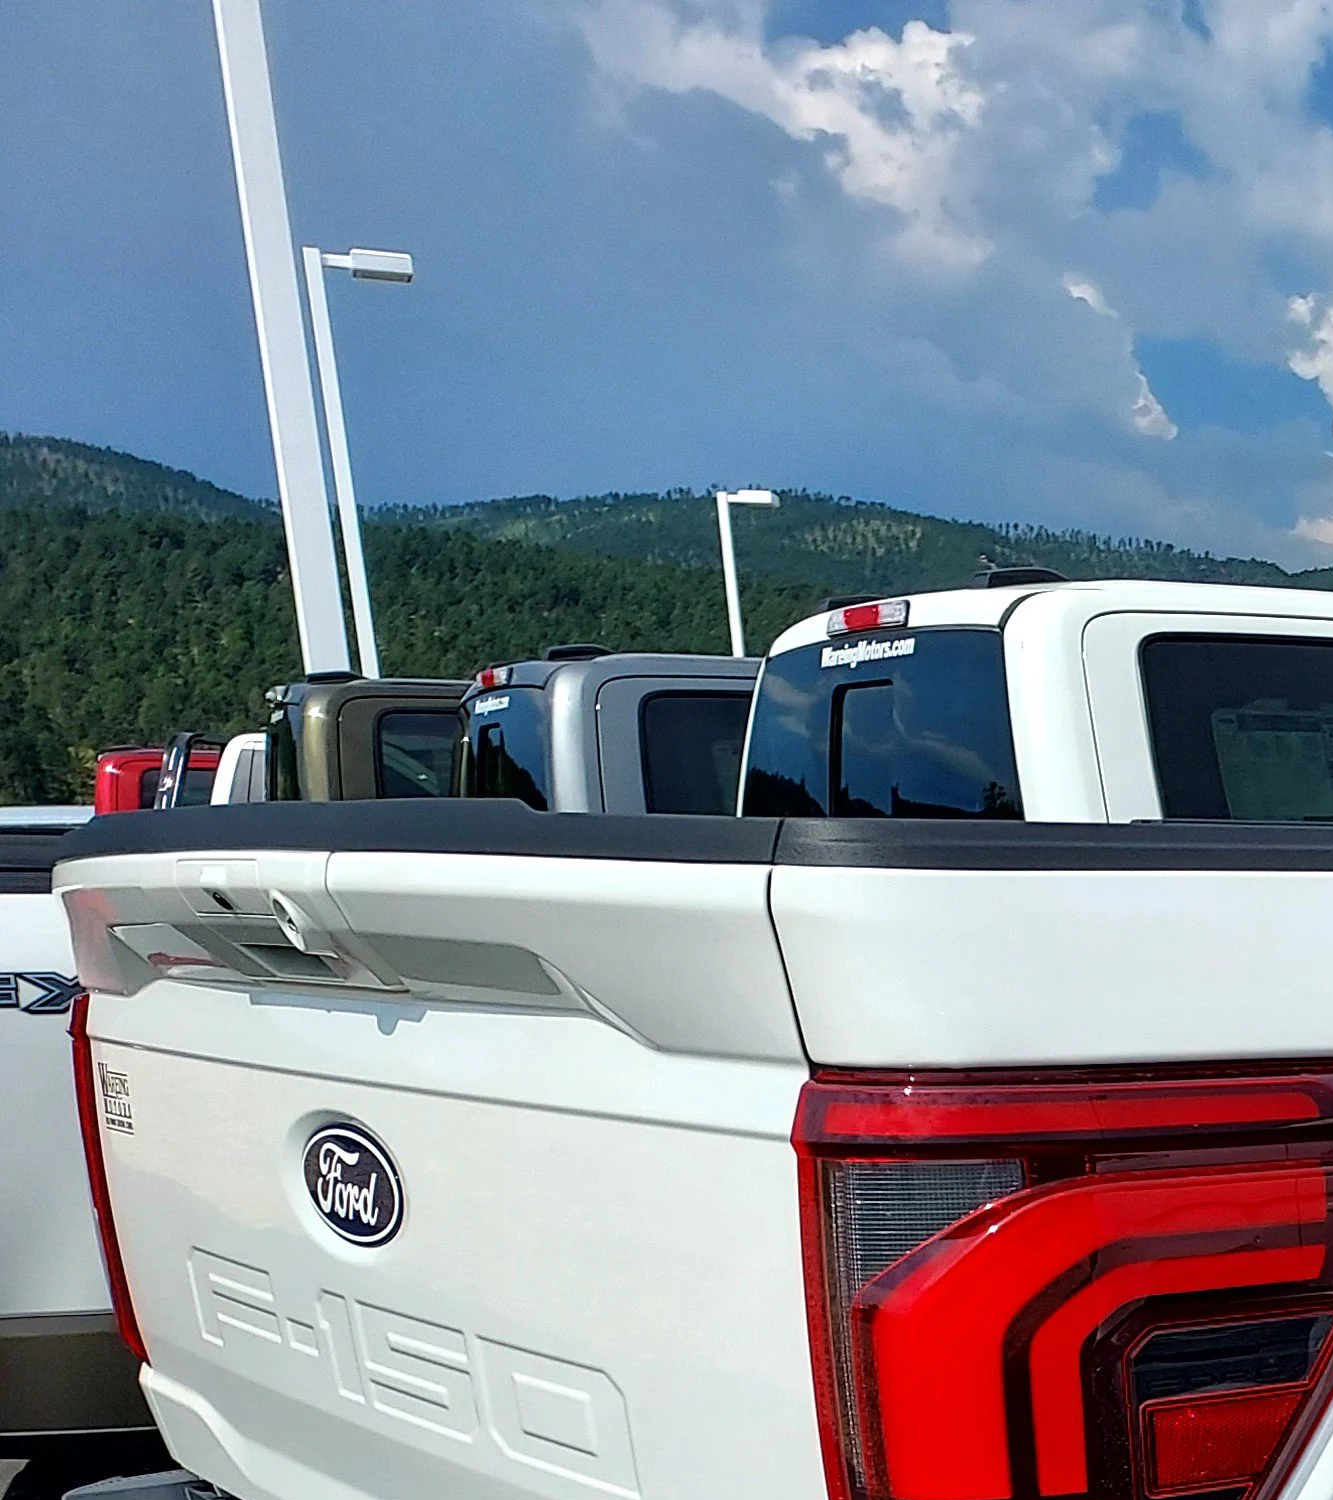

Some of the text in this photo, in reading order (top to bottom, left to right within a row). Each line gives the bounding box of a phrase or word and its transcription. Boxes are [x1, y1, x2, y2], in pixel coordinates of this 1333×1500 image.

[821, 638, 915, 668] WareingMotors.com
[318, 1142, 379, 1227] Ford
[187, 1245, 642, 1500] F-150
